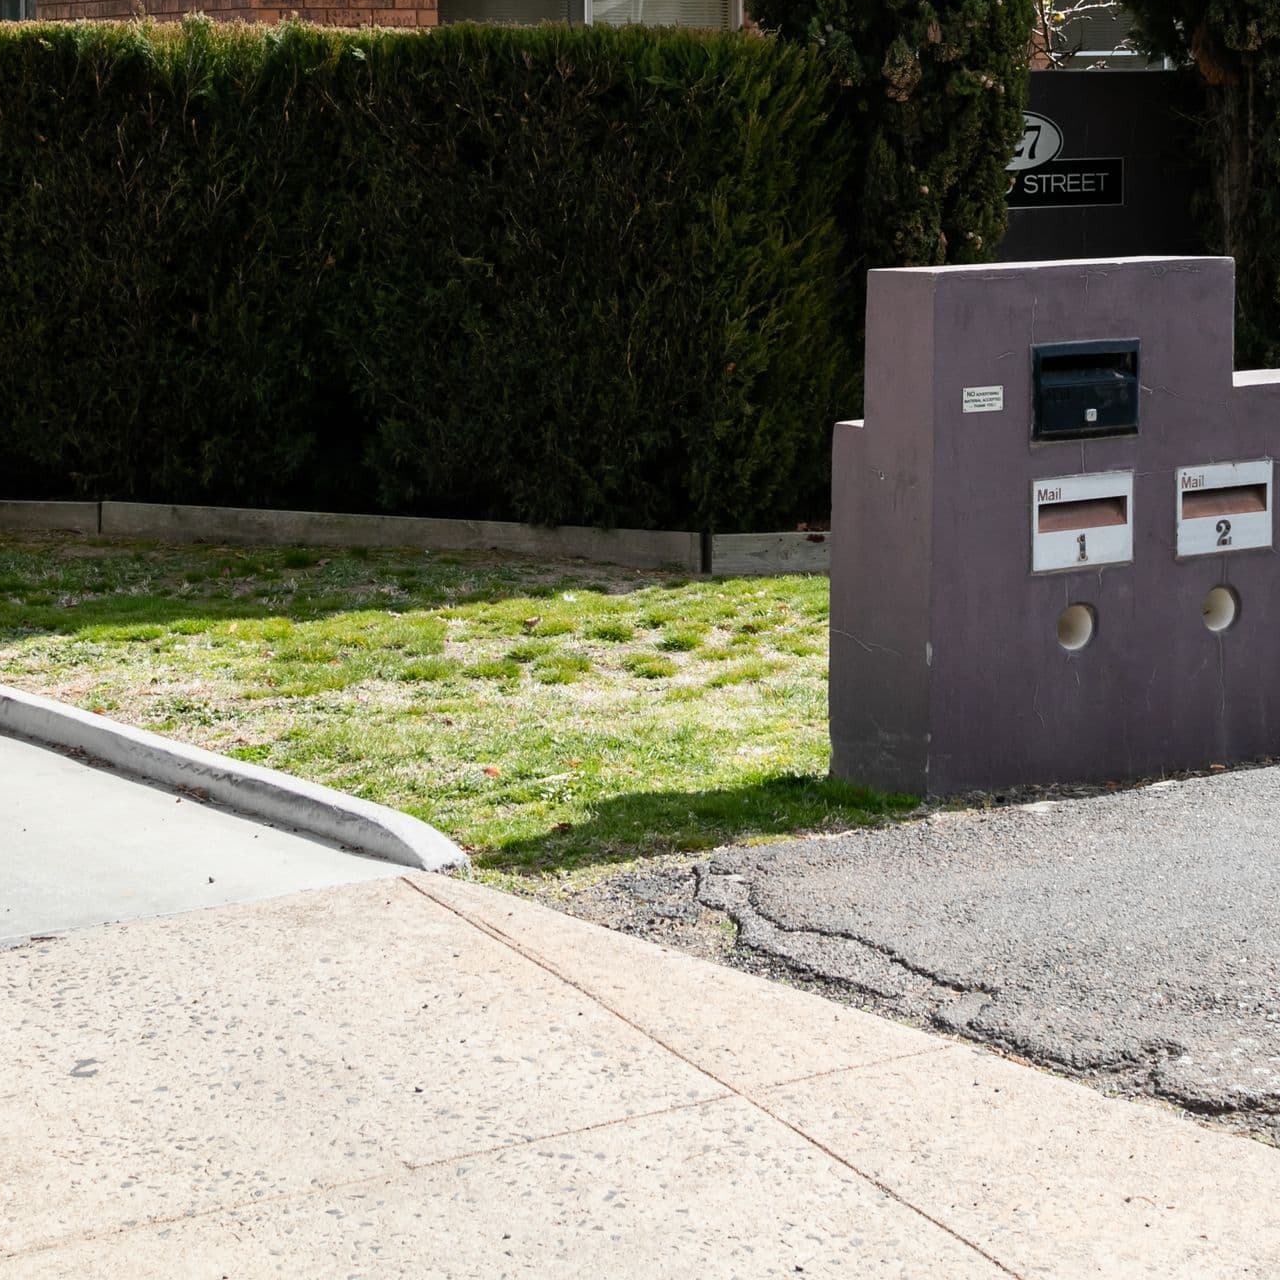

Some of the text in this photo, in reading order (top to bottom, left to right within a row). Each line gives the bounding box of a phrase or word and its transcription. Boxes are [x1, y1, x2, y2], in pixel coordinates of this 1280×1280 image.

[1023, 173, 1110, 194] STREET
[1181, 476, 1205, 489] Mail
[1037, 488, 1062, 502] Mail
[1215, 519, 1232, 546] 2
[1076, 534, 1088, 561] 1
